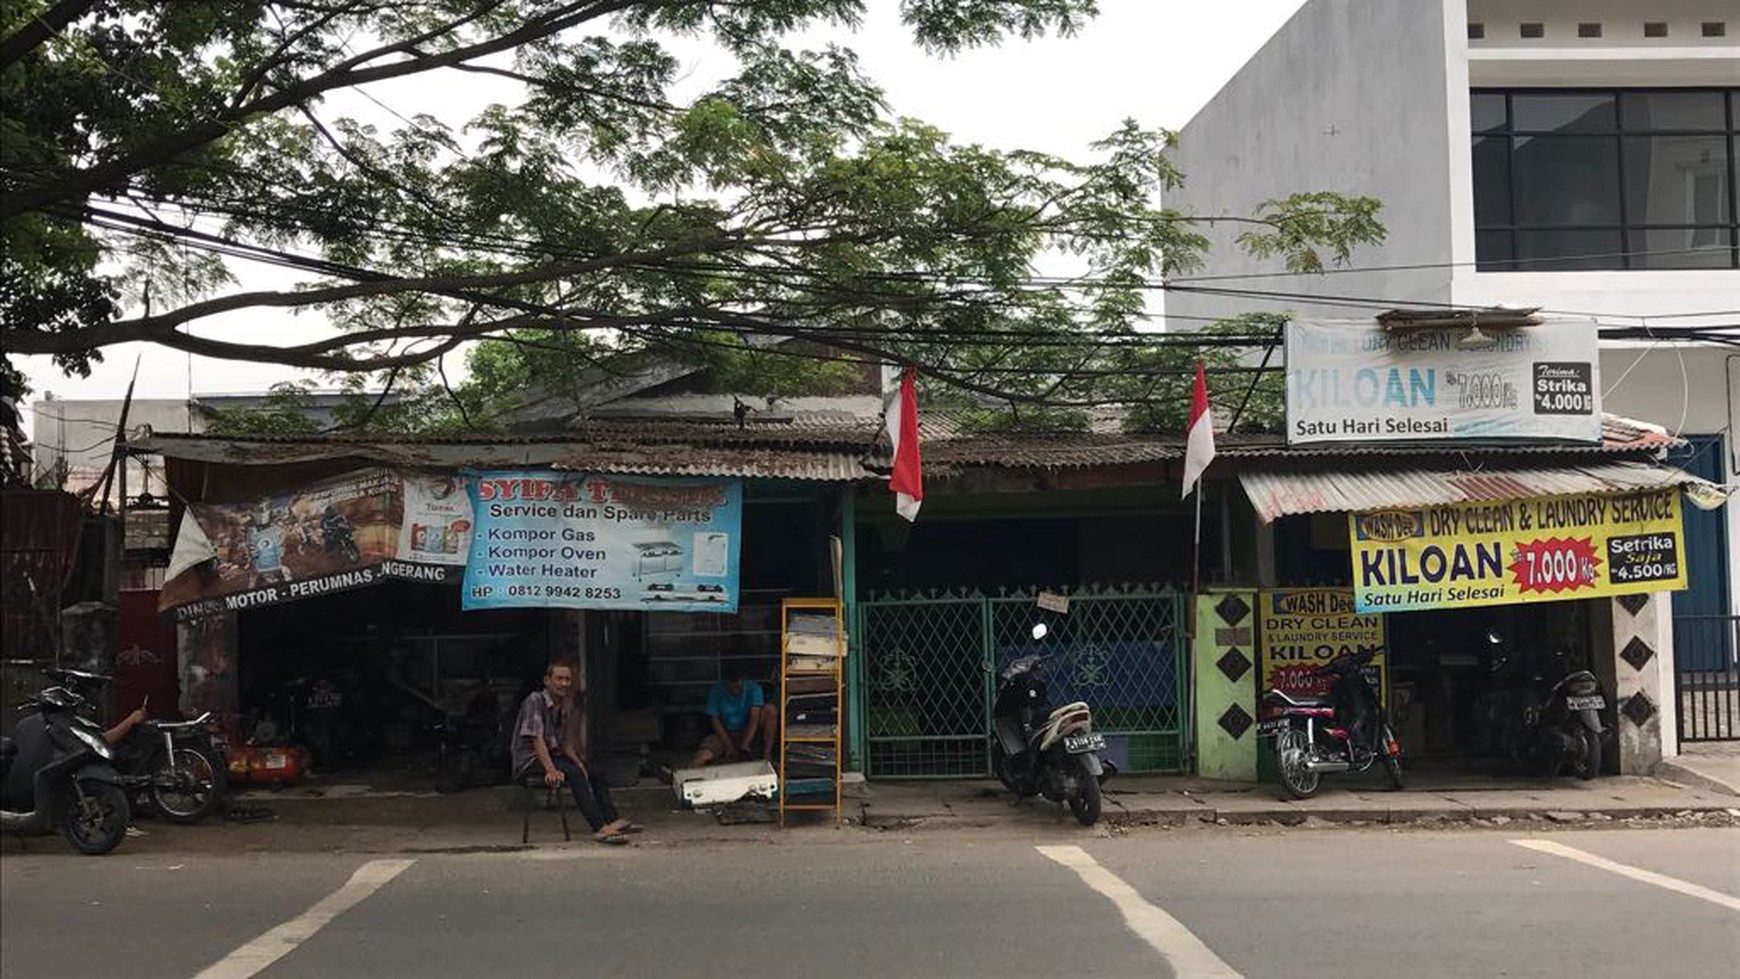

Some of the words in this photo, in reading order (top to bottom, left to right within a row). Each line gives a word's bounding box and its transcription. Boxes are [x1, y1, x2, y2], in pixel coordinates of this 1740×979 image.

[1294, 367, 1436, 408] KILOAN
[1537, 379, 1587, 392] Strika
[1296, 420, 1337, 437] Satu
[1342, 418, 1380, 434] Hari
[1385, 417, 1449, 434] Selesai
[490, 503, 557, 518] Service
[563, 504, 598, 519] dan
[603, 505, 658, 523] Spare
[663, 508, 712, 522] Parts
[1430, 507, 1461, 537] DRY
[1466, 503, 1515, 535] CLEAN
[1519, 503, 1533, 531] &
[1537, 497, 1608, 530] LAUNDRY
[1612, 491, 1674, 524] SERVICE
[488, 528, 556, 542] Kompor
[561, 528, 596, 542] Gas
[488, 546, 556, 560] Kompor
[561, 546, 607, 561] Oven
[1611, 536, 1674, 554] Setrika
[488, 564, 537, 577] Water
[541, 564, 599, 579] Heater
[1360, 542, 1503, 587] KILOAN
[225, 588, 279, 609] MOTOR
[290, 569, 374, 597] PERUMNAS
[508, 585, 542, 597] 0812
[545, 586, 581, 598] 9942
[585, 587, 622, 599] 8253
[1364, 592, 1402, 607] Satu
[1407, 588, 1443, 603] Hari
[1447, 584, 1505, 601] Selesai
[1285, 593, 1326, 614] WASH
[1266, 618, 1305, 631] DRY
[1311, 617, 1378, 630] CLEAN
[1276, 632, 1327, 643] LAUNDRY
[1332, 631, 1378, 641] SERVICE
